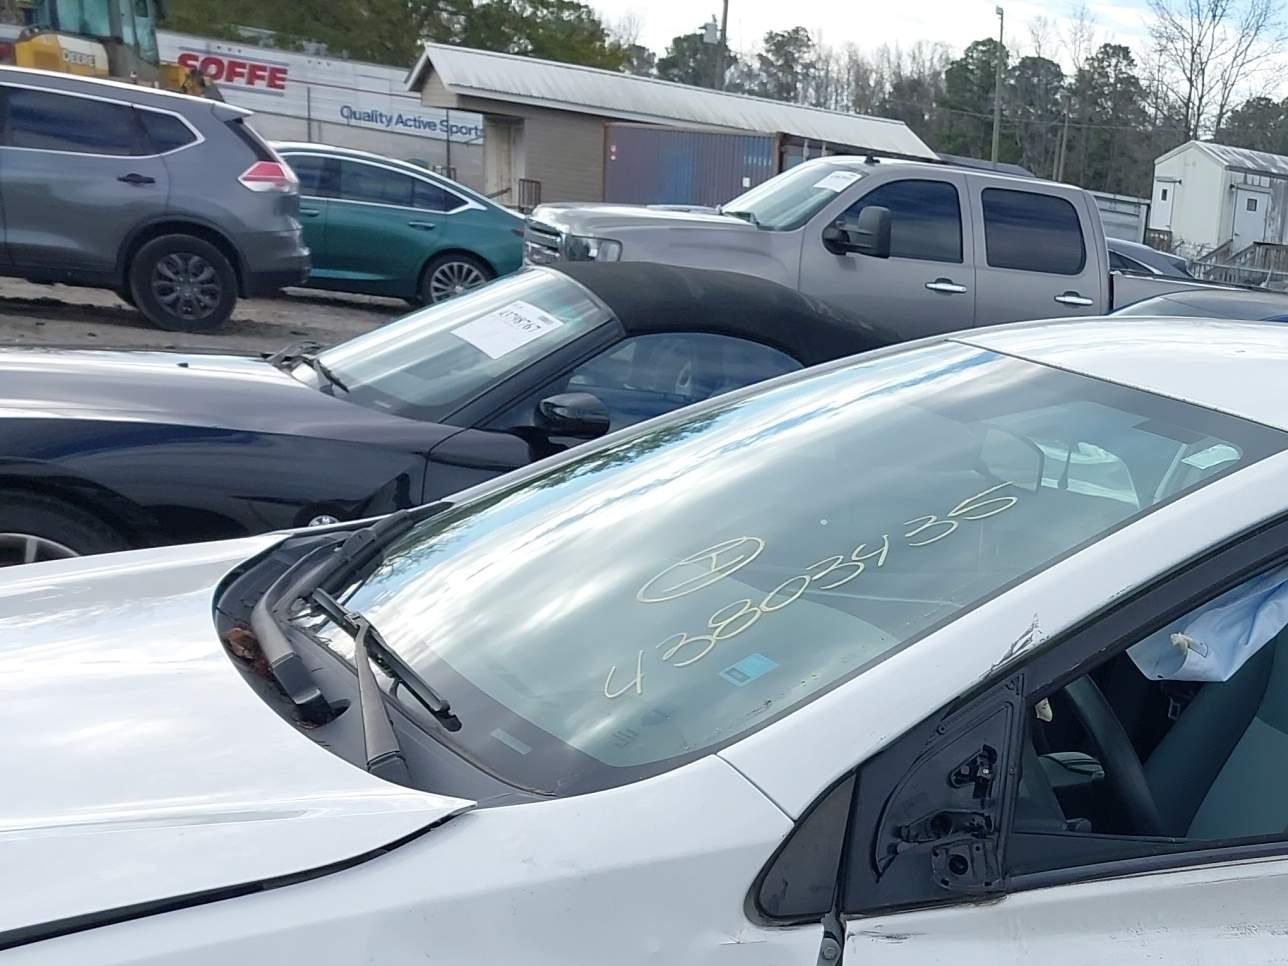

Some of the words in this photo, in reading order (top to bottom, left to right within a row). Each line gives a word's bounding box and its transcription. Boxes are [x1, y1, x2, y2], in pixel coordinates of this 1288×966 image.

[178, 53, 289, 90] SOFFE
[340, 105, 393, 127] Quality
[394, 114, 438, 131] Active
[603, 481, 1018, 698] 43803435
